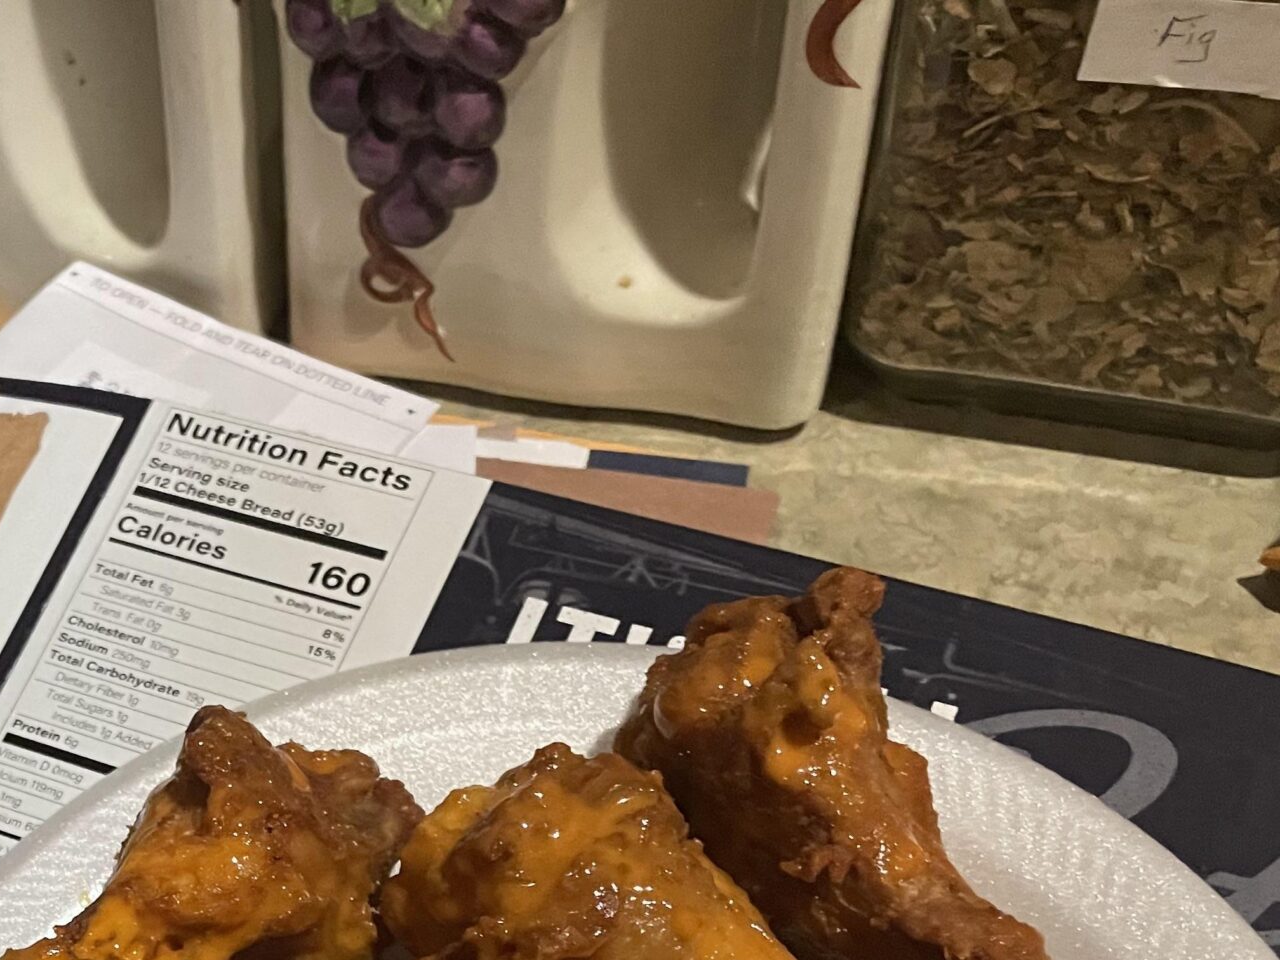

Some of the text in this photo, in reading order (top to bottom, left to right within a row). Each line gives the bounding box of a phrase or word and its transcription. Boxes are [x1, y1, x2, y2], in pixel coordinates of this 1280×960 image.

[1157, 14, 1218, 63] Fig
[89, 277, 111, 292] TO
[111, 286, 150, 310] OPEN
[164, 311, 204, 334] FOLD
[201, 328, 234, 348] AND
[232, 337, 271, 362] TEAR
[269, 354, 294, 373] ON
[293, 362, 353, 393] DOTTED
[352, 385, 393, 408] LINE
[155, 441, 327, 494] 12 servings per container
[166, 412, 413, 492] Nutrition Facts
[148, 457, 251, 493] Serving size
[124, 502, 226, 537] Amount per serving
[138, 471, 346, 538] 1/12 Cheese Bread (53g)
[117, 515, 372, 598] Calories 160
[94, 562, 131, 582] Total
[131, 574, 155, 589] Fat
[99, 584, 192, 622] Saturated Fat 3g
[285, 598, 314, 614] Daily
[67, 614, 147, 647] Cholesterol
[125, 612, 146, 628] Fat
[145, 617, 164, 633] 0g
[322, 628, 346, 643] 8%
[57, 631, 152, 671] Sodium 250mg
[307, 644, 337, 661] 15%
[50, 648, 85, 669] Total
[85, 660, 182, 698] Carbohydrate
[54, 671, 96, 692] Dietary
[95, 683, 126, 701] Fiber
[46, 688, 74, 705] Total
[73, 697, 115, 719] Sugars
[11, 718, 62, 743] Protein
[51, 710, 98, 733] Includes
[113, 729, 155, 751] Added
[38, 758, 52, 773] D
[51, 763, 84, 785] 0mcg
